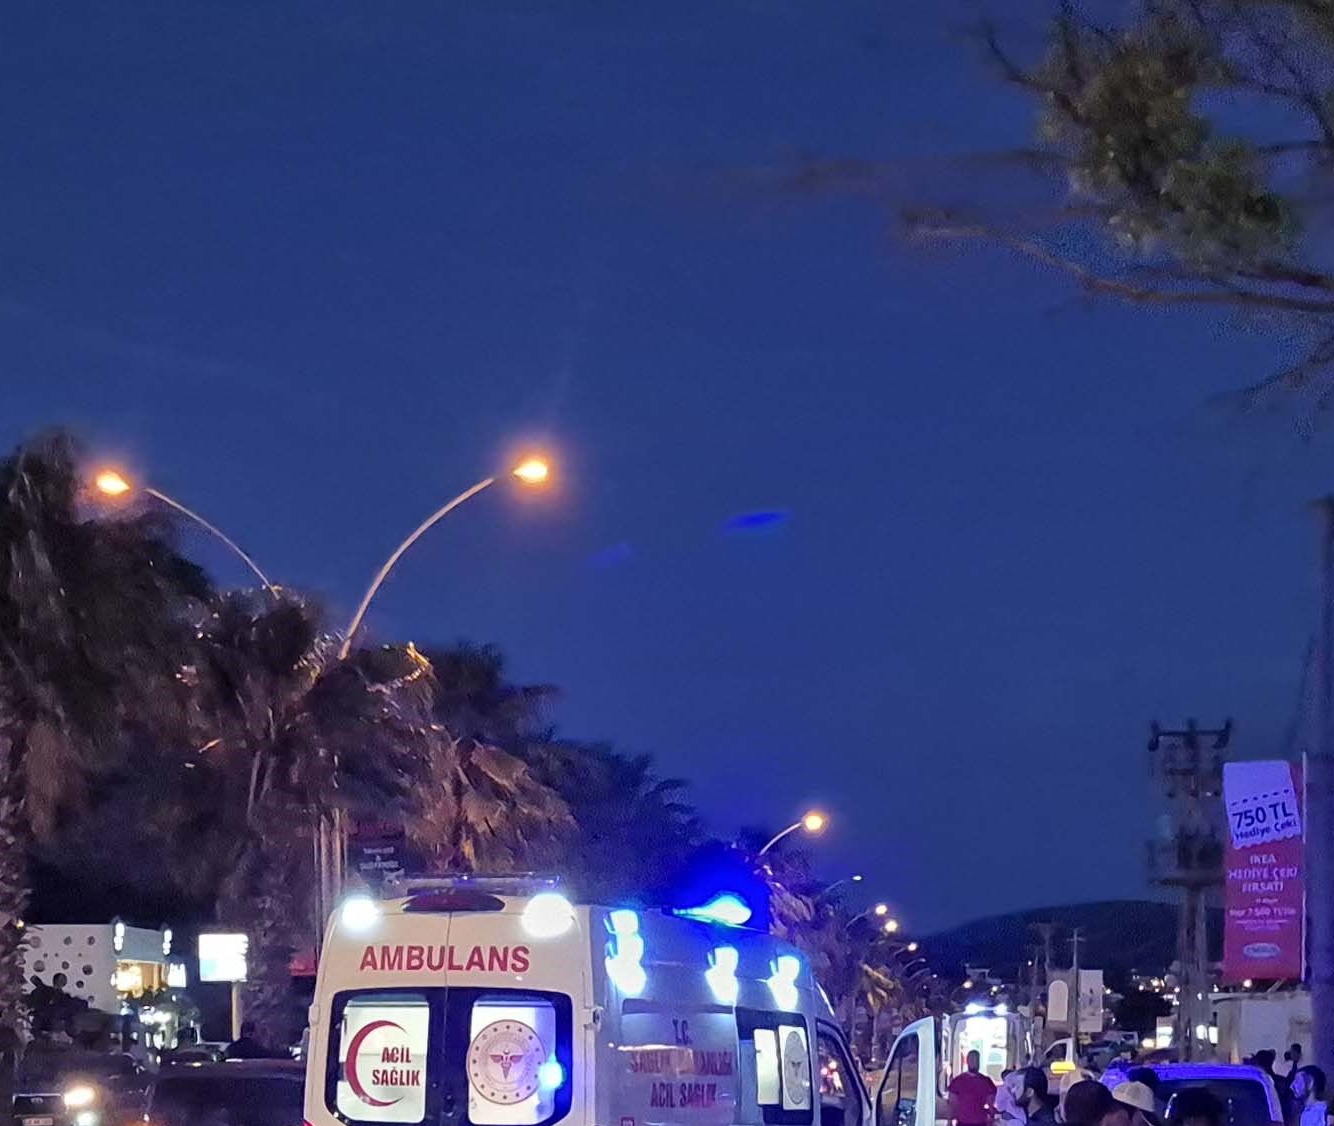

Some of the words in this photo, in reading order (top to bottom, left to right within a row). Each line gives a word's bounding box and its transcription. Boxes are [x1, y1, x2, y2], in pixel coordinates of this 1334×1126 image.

[1232, 805, 1267, 829] 750
[1269, 801, 1294, 820] TL
[359, 944, 530, 973] AMBULANS
[381, 1045, 411, 1064] ACİL
[372, 1067, 420, 1087] SAĞLIK
